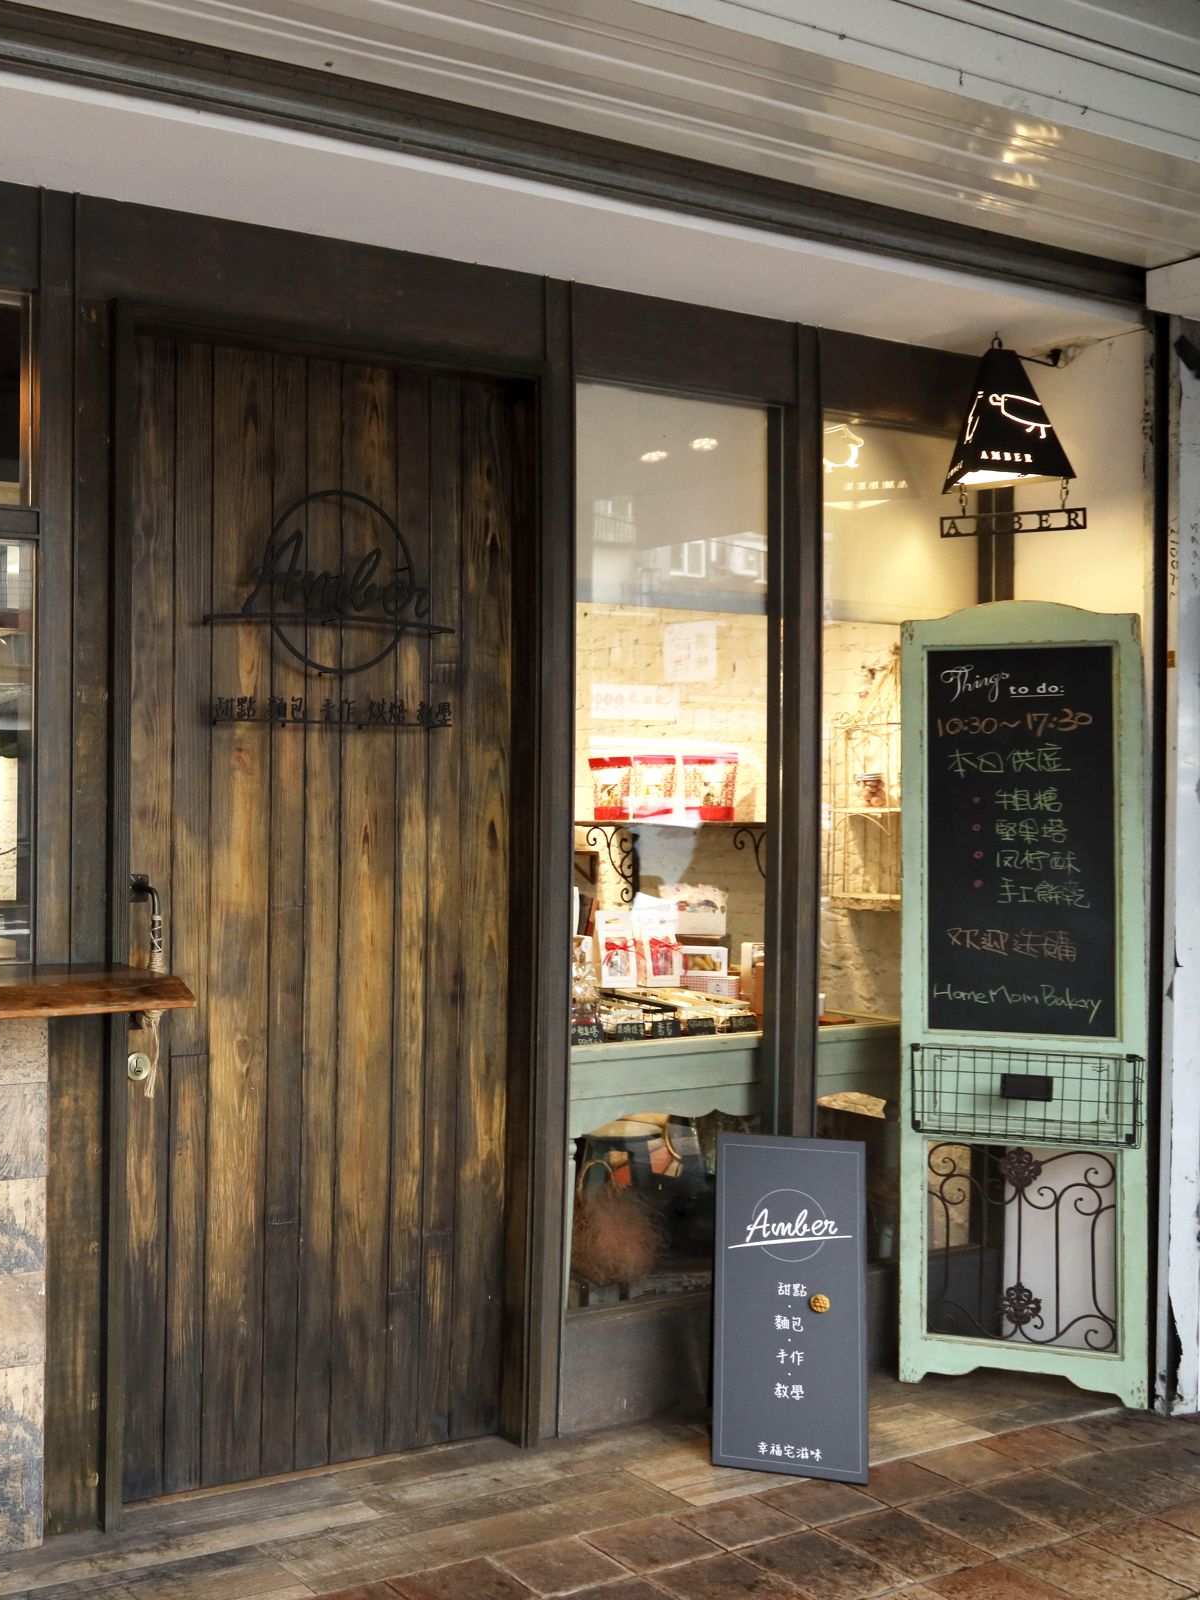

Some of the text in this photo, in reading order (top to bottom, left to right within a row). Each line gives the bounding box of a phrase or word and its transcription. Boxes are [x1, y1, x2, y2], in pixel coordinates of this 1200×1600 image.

[980, 450, 1033, 463] AMBER
[945, 510, 1082, 537] ABER
[940, 664, 1065, 702] Things to do:
[319, 697, 355, 721] 手作
[995, 817, 1069, 845] 堅果塔
[745, 1208, 838, 1243] Amber
[777, 1281, 808, 1297] 甜點
[774, 1314, 804, 1332] 麵包
[775, 1348, 805, 1366] 手作
[773, 1382, 805, 1400] 教學
[757, 1441, 823, 1462] 幸福宅滋味
